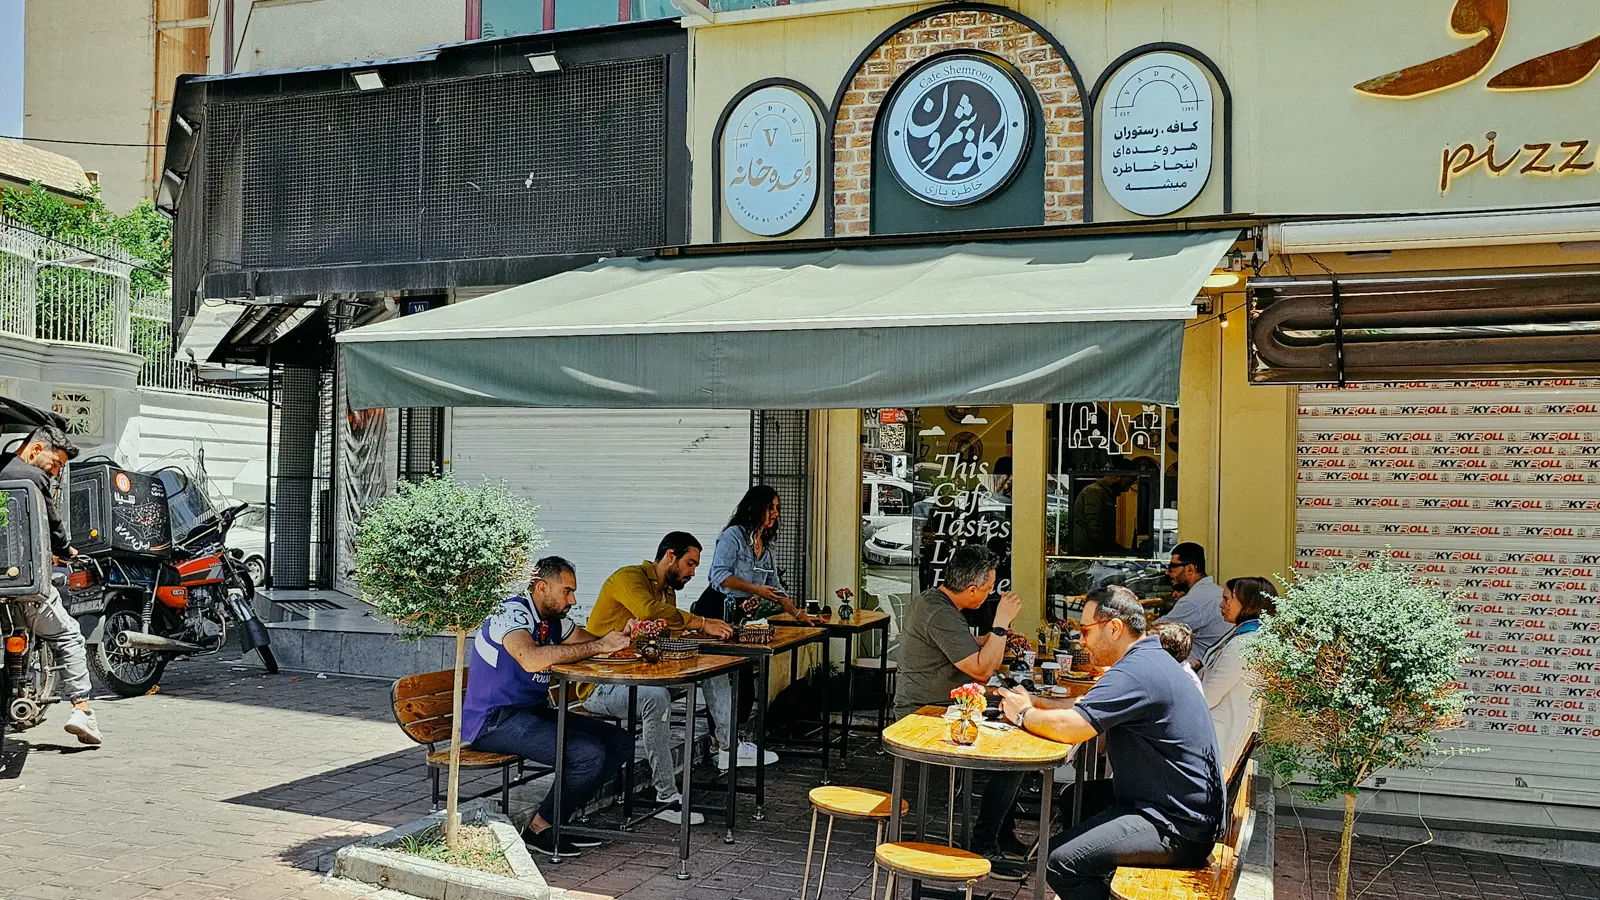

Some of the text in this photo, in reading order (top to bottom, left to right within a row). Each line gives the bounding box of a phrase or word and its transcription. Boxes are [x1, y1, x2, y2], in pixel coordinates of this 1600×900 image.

[919, 65, 994, 89] Cafe Shemroon
[763, 128, 778, 147] V
[1114, 125, 1159, 140] رستوران
[1172, 142, 1198, 155] هر
[1112, 158, 1198, 176] اینجا خاطره
[1439, 131, 1600, 193] pizz
[925, 180, 983, 200] خاطره بازی
[1125, 178, 1188, 192] میشه
[1297, 446, 1339, 455] KYROLL
[934, 452, 989, 479] This
[933, 511, 1011, 538] Tastes
[930, 539, 966, 564] Li
